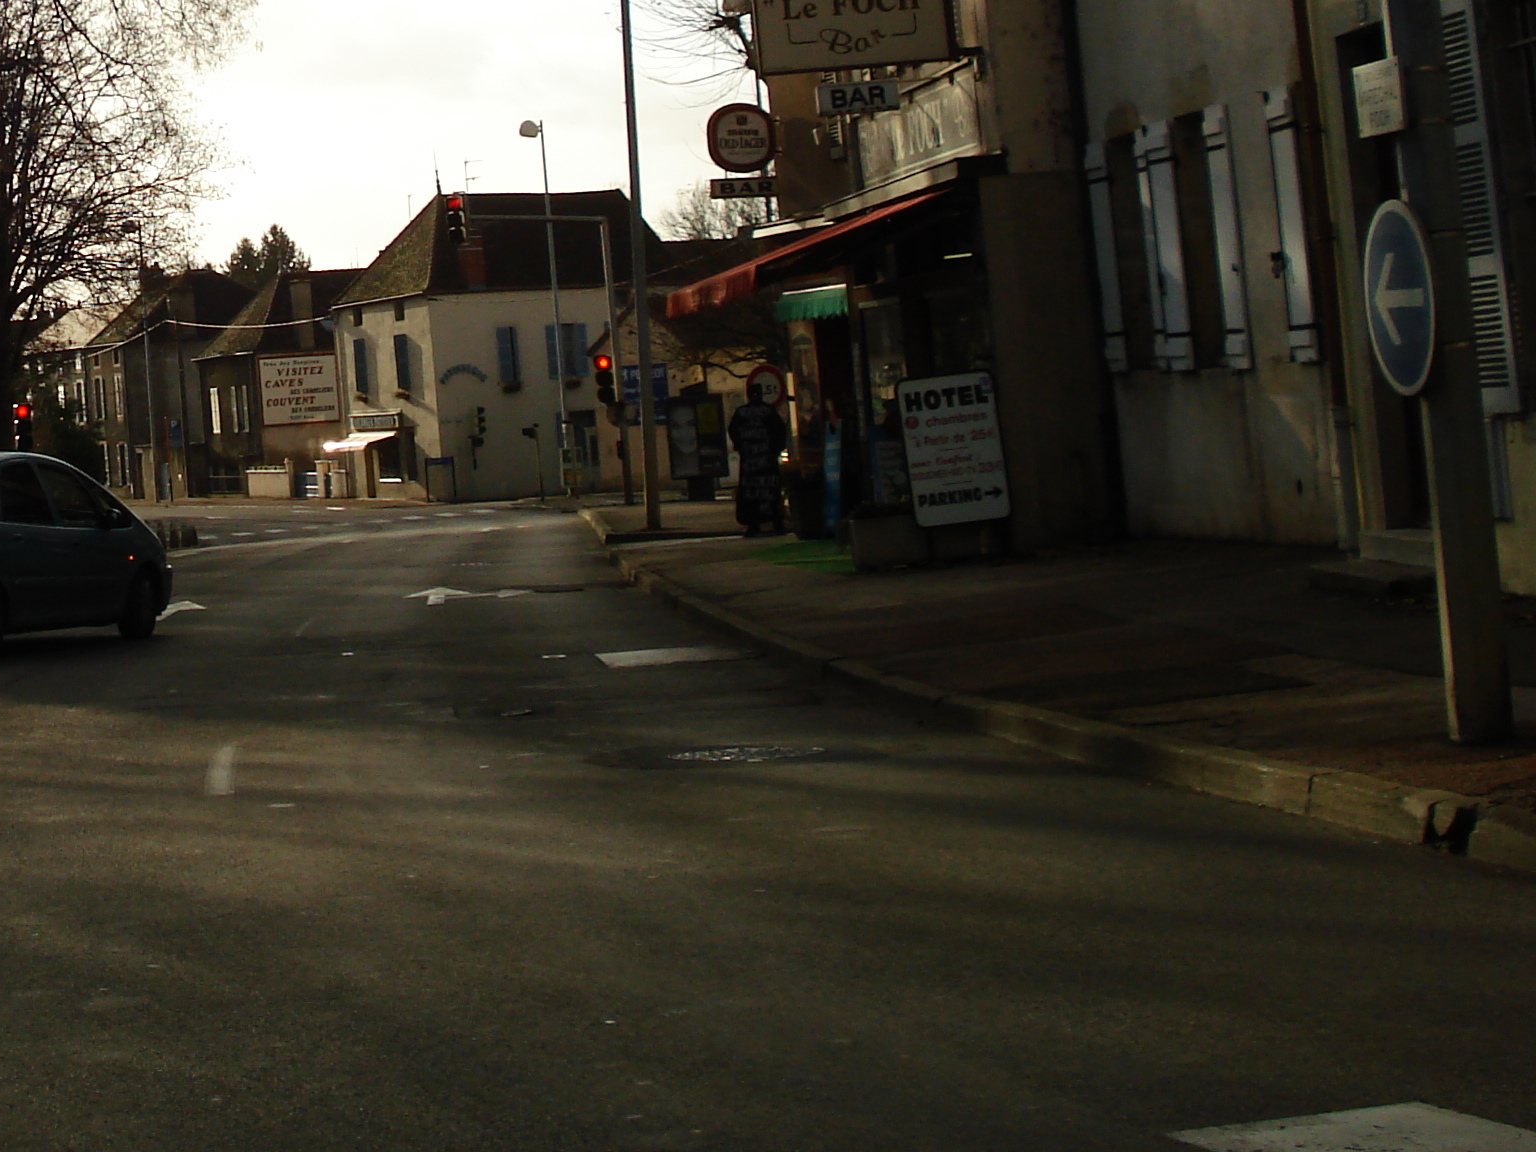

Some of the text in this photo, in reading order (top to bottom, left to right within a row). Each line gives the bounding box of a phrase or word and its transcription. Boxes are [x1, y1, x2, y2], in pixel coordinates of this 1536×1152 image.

[820, 27, 888, 55] Bar
[830, 84, 887, 109] BAR
[720, 181, 773, 194] BAR
[277, 366, 324, 377] VISITEZ
[265, 378, 304, 389] CAVES
[266, 396, 316, 408] COUVENT
[904, 384, 989, 412] HOTEL
[925, 412, 987, 428] chambres
[918, 487, 983, 507] PARKING
